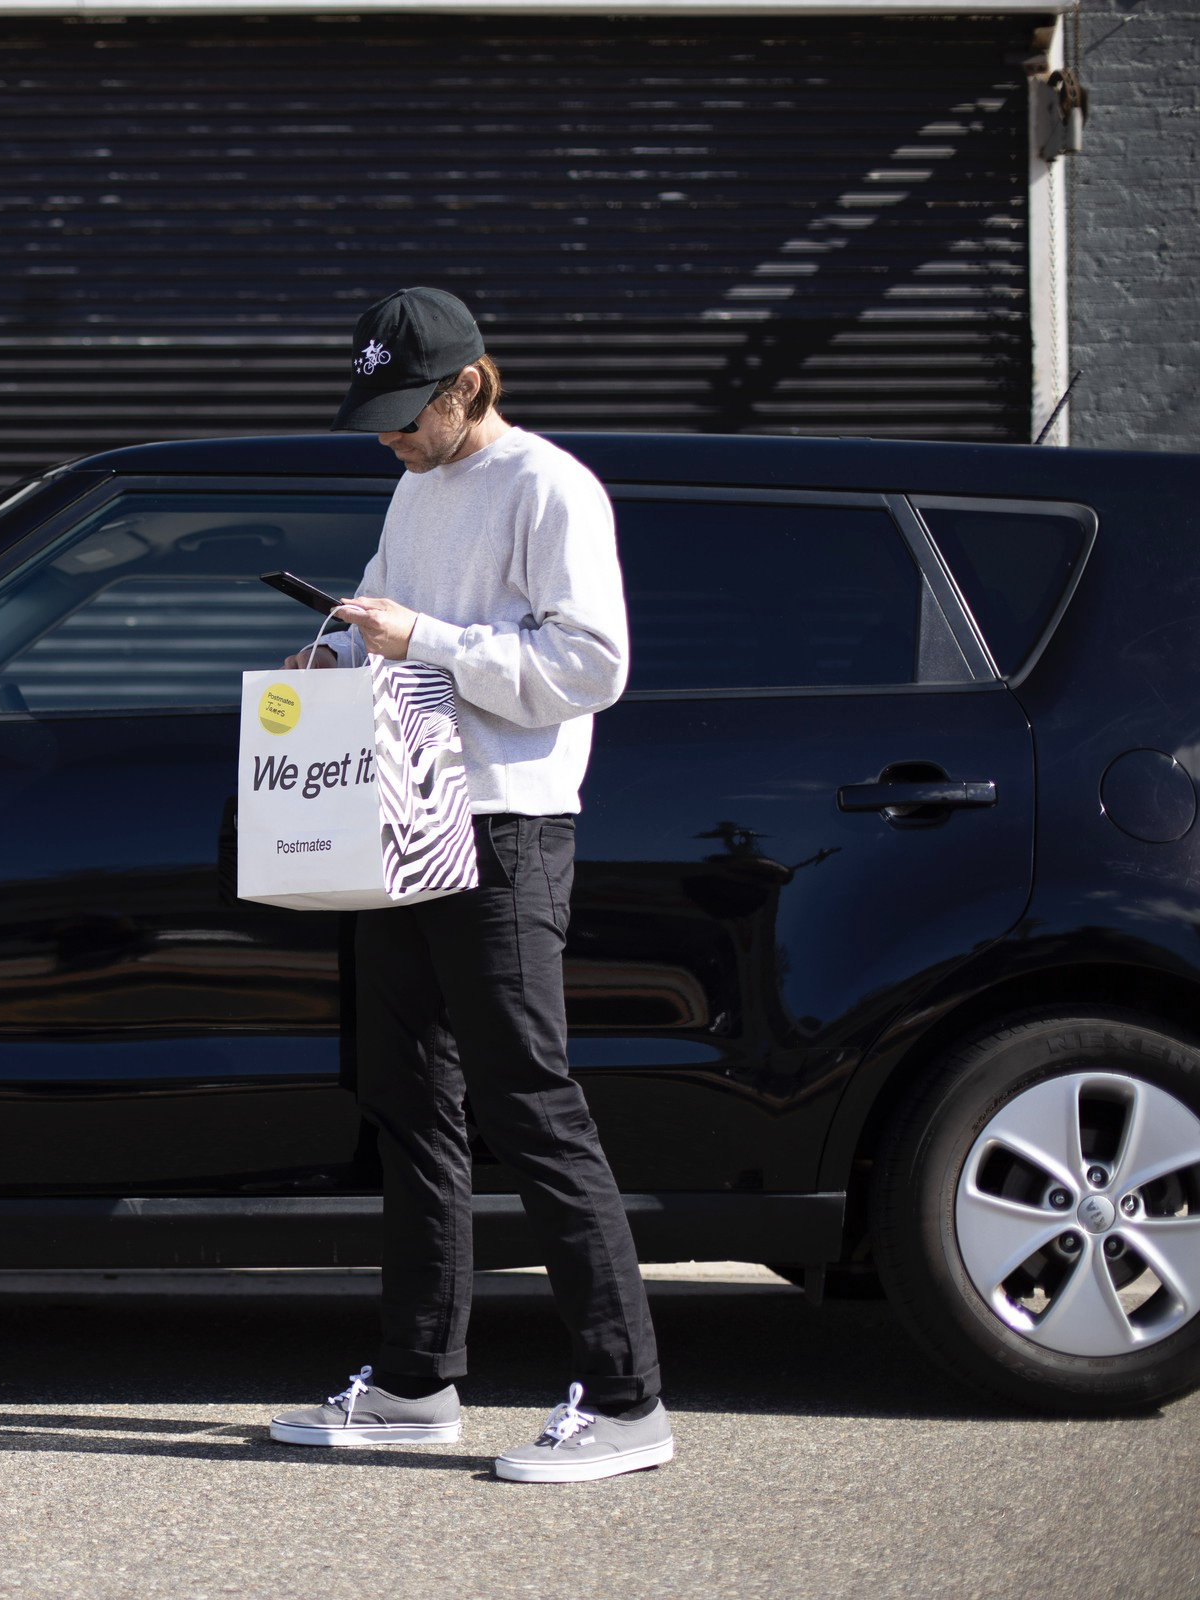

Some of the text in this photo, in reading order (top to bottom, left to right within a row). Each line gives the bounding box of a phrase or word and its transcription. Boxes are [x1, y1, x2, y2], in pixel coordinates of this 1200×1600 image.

[268, 692, 294, 707] Postmates
[266, 701, 286, 717] James
[253, 748, 376, 799] We get it.
[276, 838, 332, 855] Postmates
